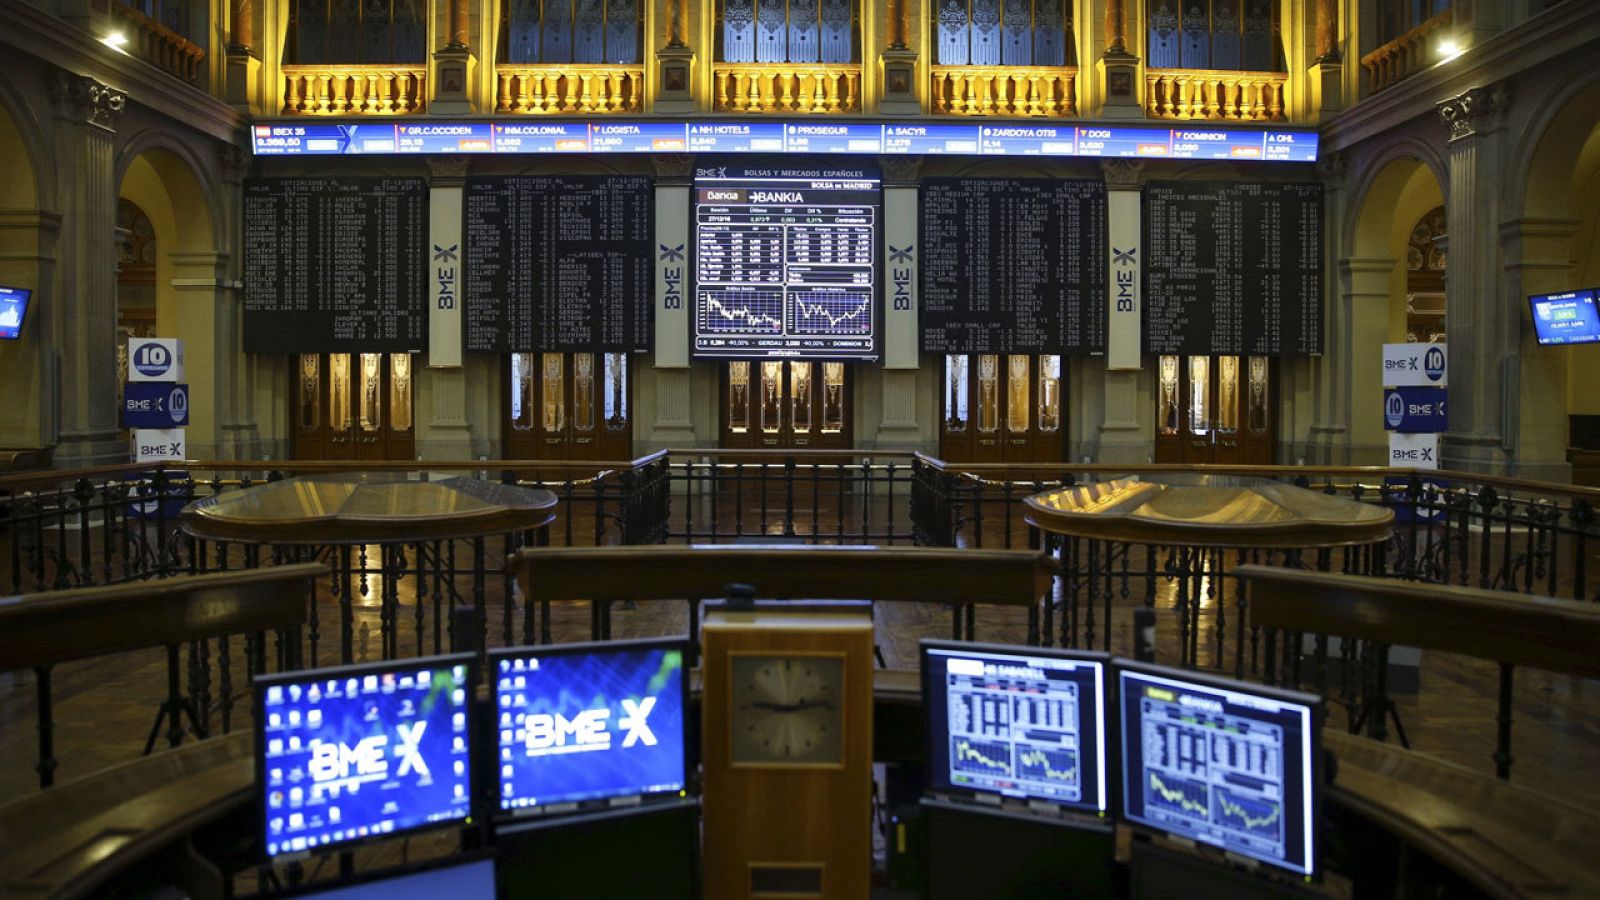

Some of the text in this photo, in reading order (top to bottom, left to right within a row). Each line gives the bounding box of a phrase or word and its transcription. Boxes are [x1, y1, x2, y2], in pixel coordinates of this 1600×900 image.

[602, 126, 640, 134] LOGISTA
[700, 126, 750, 134] NH HOTELS
[992, 128, 1056, 137] ZARDOYA OTIS
[1089, 130, 1110, 138] DOGI
[1184, 132, 1226, 140] DOMINION
[1277, 134, 1294, 142] OHL
[824, 169, 863, 177] ESPAÑOLES
[708, 192, 738, 200] Bankia
[759, 192, 803, 202] BANKIA
[438, 267, 453, 309] BME
[665, 267, 680, 309] BME
[894, 269, 909, 310] BME
[1118, 271, 1132, 312] BME
[142, 348, 165, 365] 10
[1429, 352, 1442, 369] 10
[1385, 360, 1405, 369] BME
[127, 400, 150, 409] BME
[173, 393, 184, 409] 10
[1390, 398, 1400, 414] 10
[1409, 405, 1432, 414] BME
[141, 446, 166, 455] BME
[1393, 450, 1417, 459] BME
[525, 708, 610, 750] BME
[313, 735, 388, 781] BME
